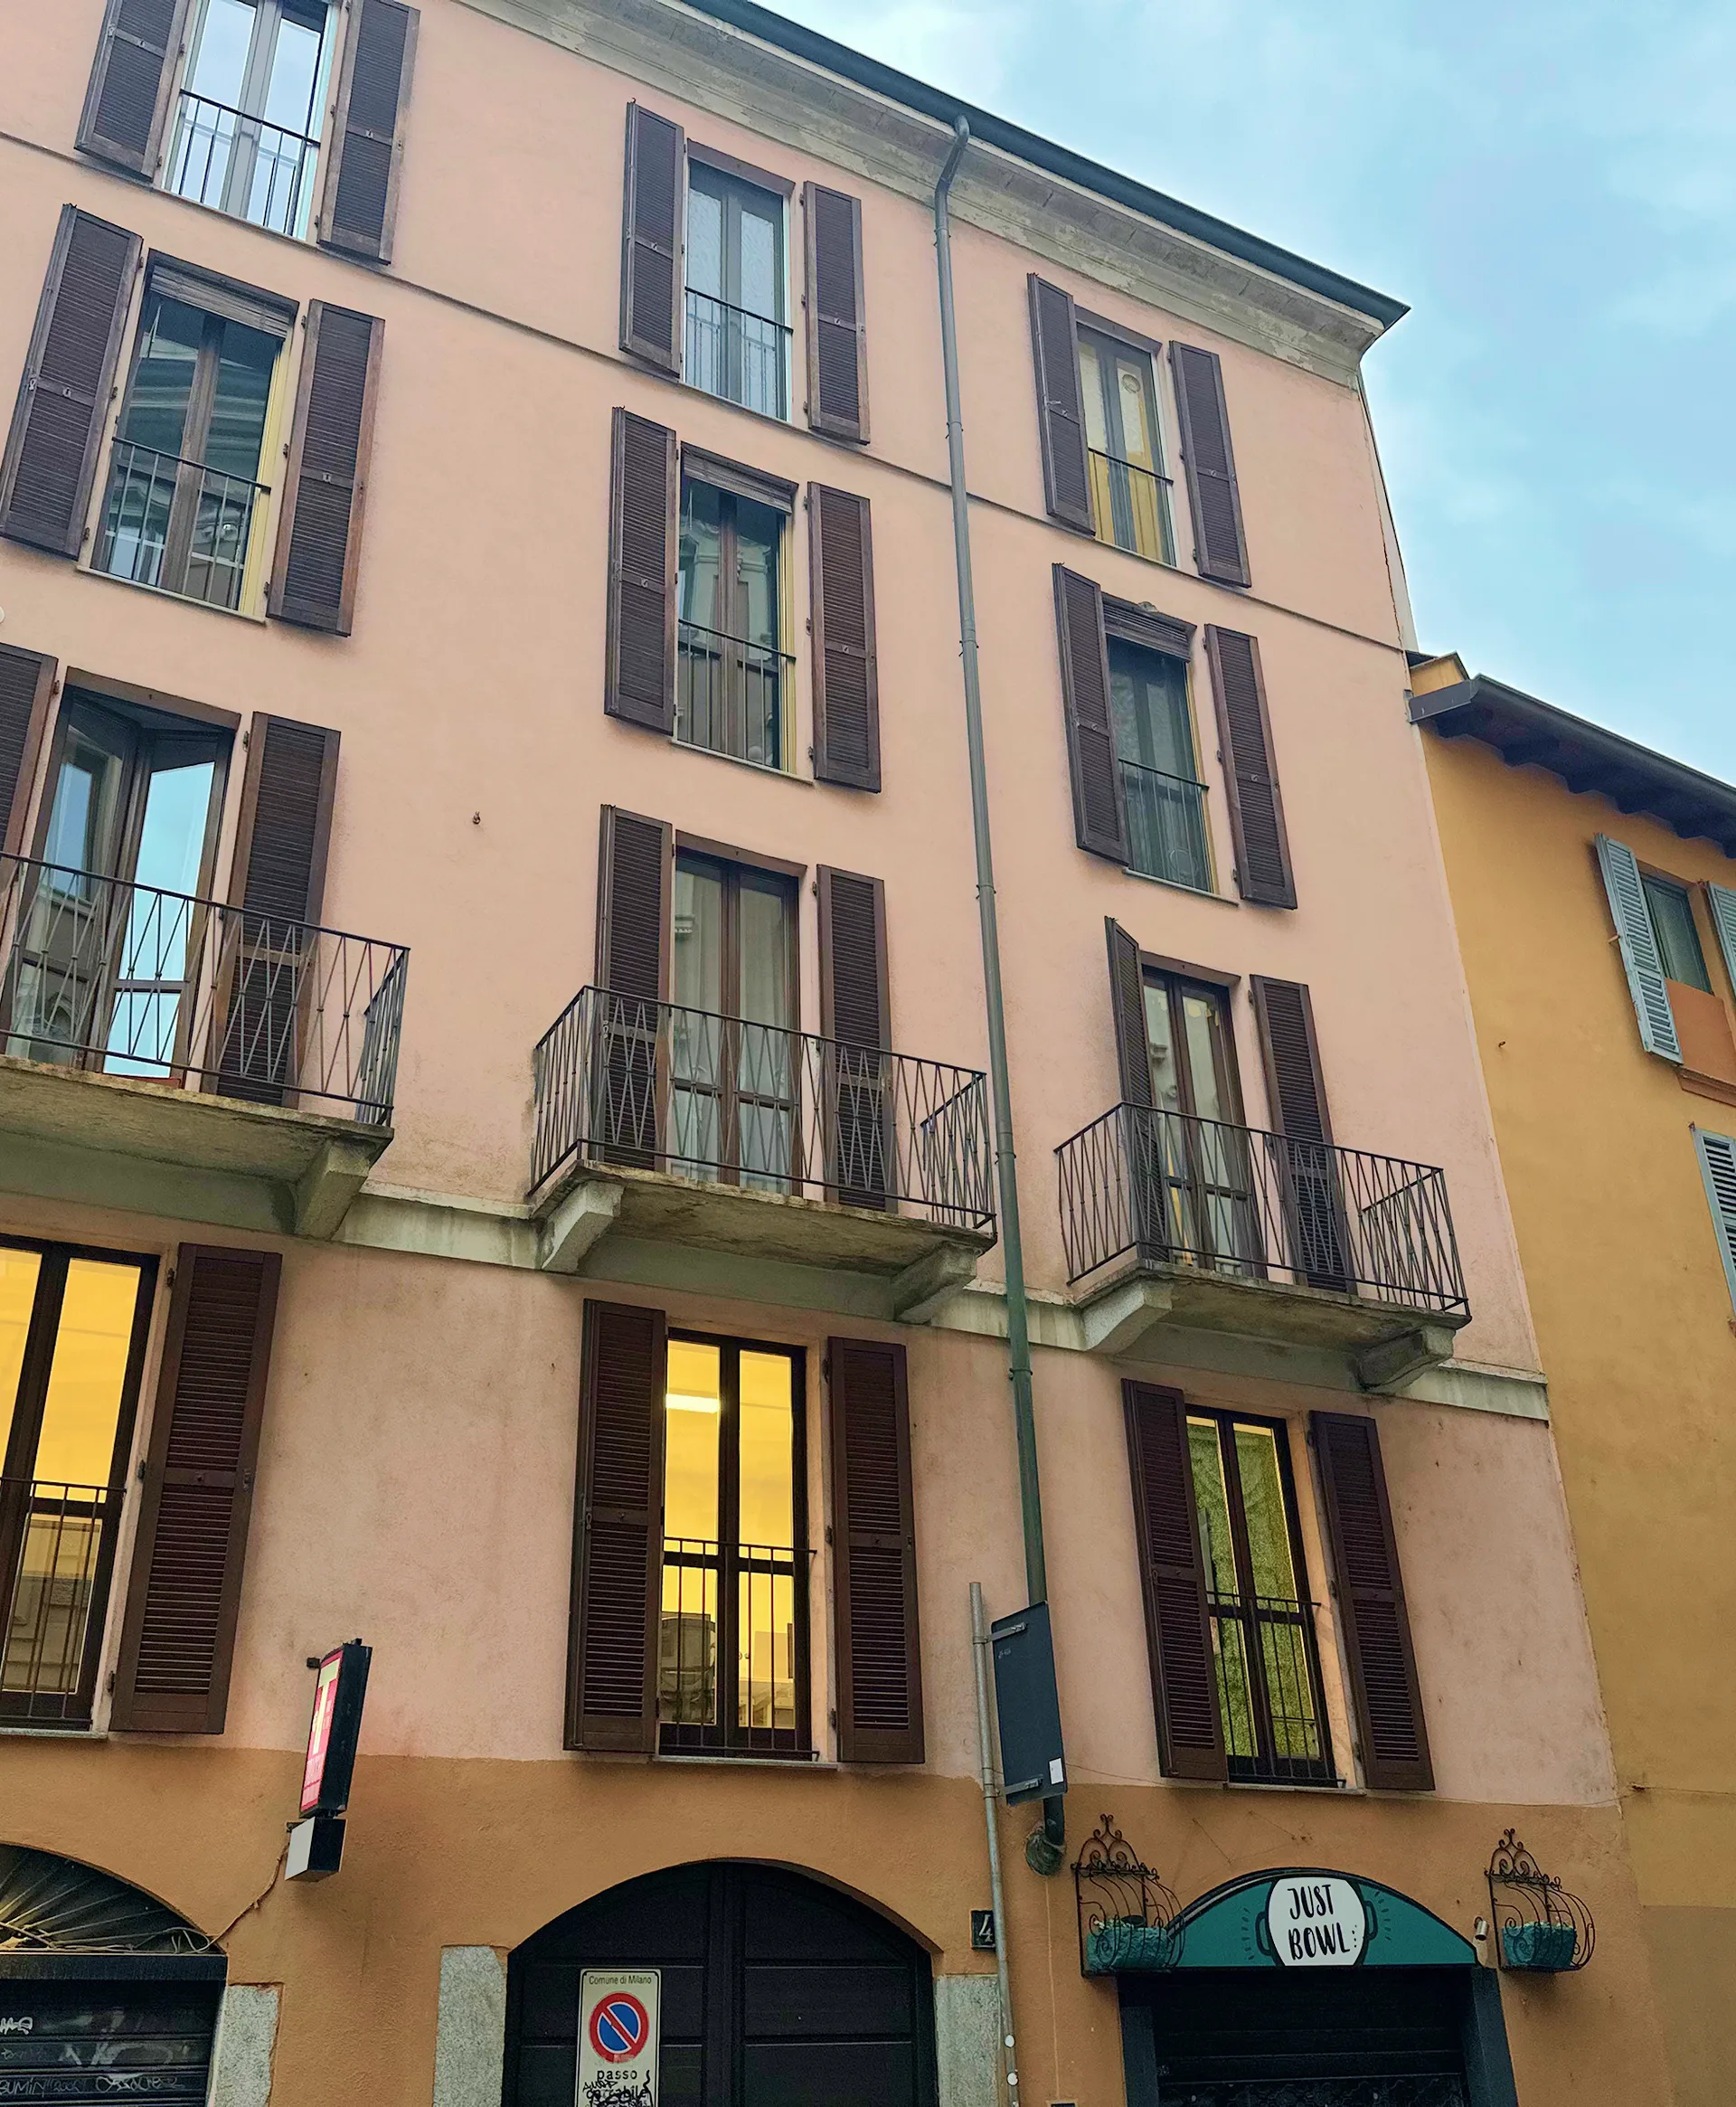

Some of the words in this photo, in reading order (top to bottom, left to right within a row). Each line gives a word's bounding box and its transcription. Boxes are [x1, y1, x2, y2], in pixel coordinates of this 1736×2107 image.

[1288, 1884, 1334, 1920] JUST
[979, 1913, 993, 1942] 4
[1288, 1922, 1350, 1961] BOWL
[589, 1975, 618, 1985] Comune
[619, 1975, 627, 1984] di
[628, 1974, 652, 1985] Milano
[597, 2070, 637, 2082] passo
